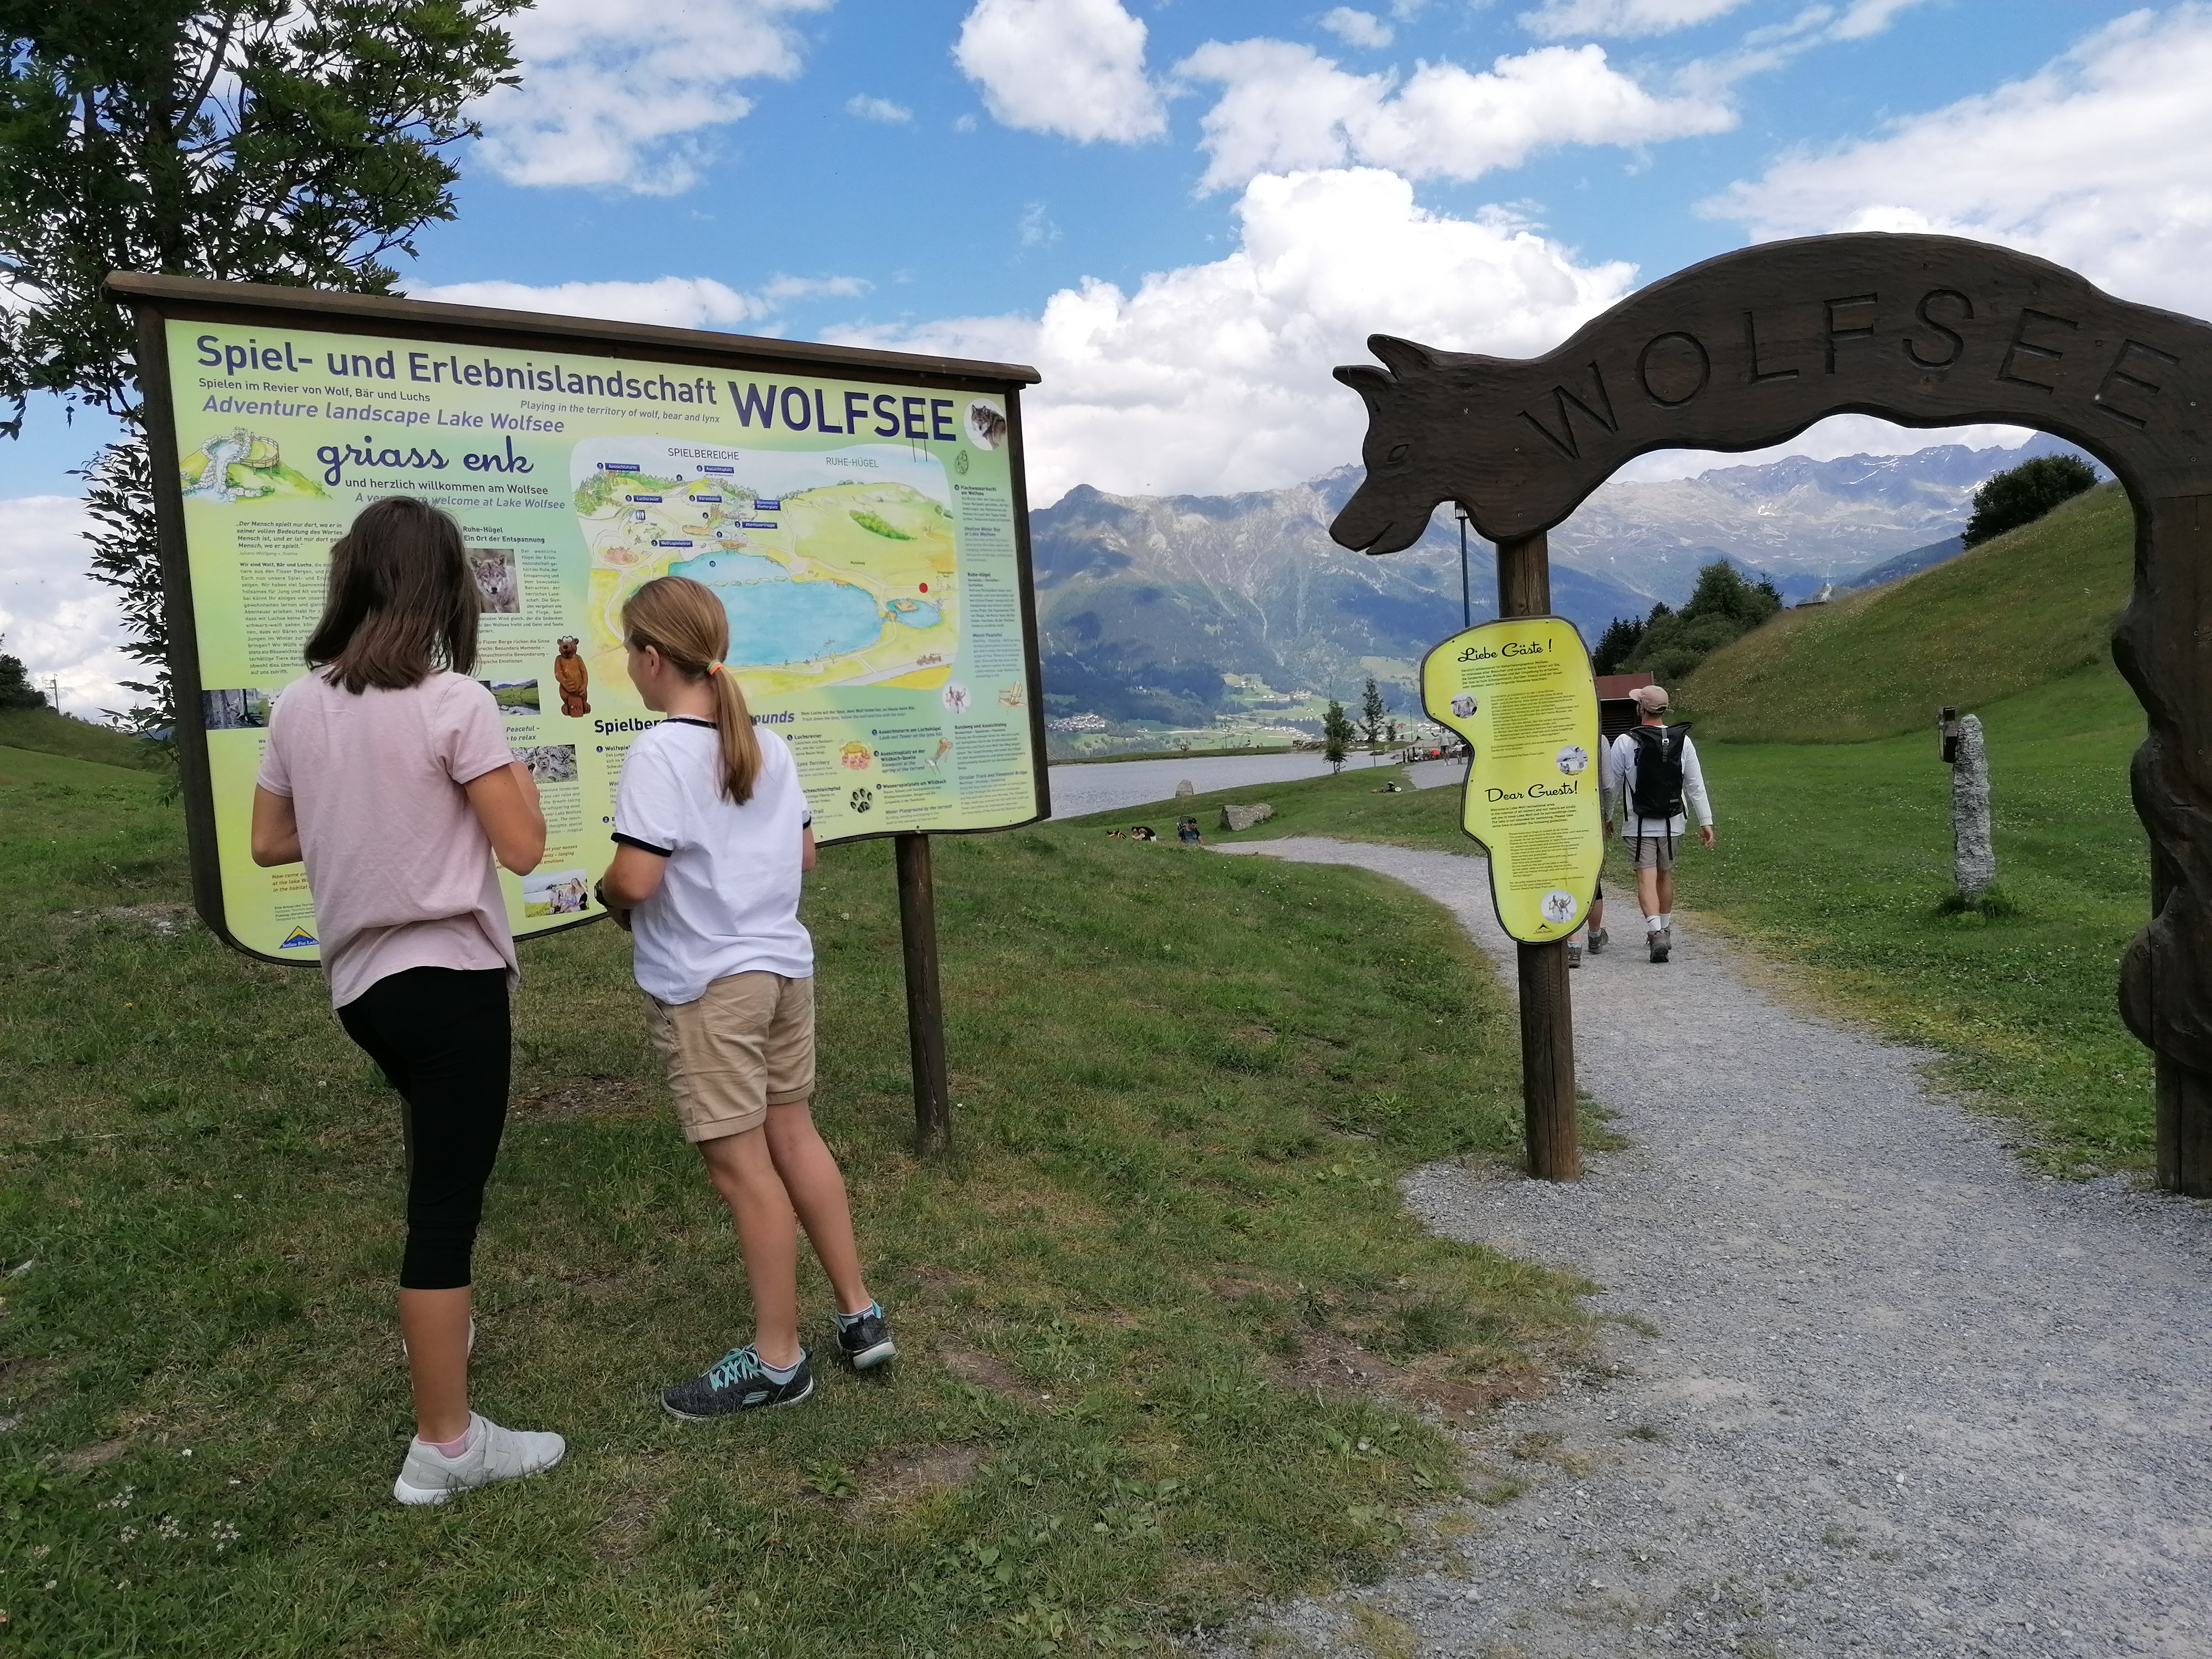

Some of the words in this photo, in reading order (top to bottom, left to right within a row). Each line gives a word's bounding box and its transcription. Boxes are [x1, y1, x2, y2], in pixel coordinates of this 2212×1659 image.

[196, 335, 313, 376] Spiel-
[327, 350, 395, 380] und
[410, 352, 716, 405] Erlebnislandschaft
[1517, 289, 2180, 462] WOLFSEE
[199, 378, 242, 392] Spielen
[246, 380, 259, 389] im
[263, 381, 299, 393] Revier
[302, 384, 321, 394] von
[324, 385, 352, 398] Wolf,
[355, 388, 374, 398] Bär
[378, 389, 397, 399] und
[400, 390, 431, 401] Luchs
[201, 395, 318, 418] Adventure
[326, 401, 431, 427] landscape
[437, 409, 483, 428] Lake
[490, 412, 565, 434] Wolfsee
[520, 400, 555, 413] Playing
[559, 403, 566, 411] in
[570, 405, 584, 413] the
[587, 406, 626, 418] territory
[629, 408, 637, 416] of
[640, 410, 660, 419] wolf,
[663, 411, 682, 420] bear
[685, 413, 700, 421] and
[702, 414, 720, 424] lynx
[727, 380, 957, 442] WOLFSEE
[316, 435, 450, 487] griass
[463, 436, 534, 473] enk
[667, 447, 740, 461] SPIELBEREICHE
[826, 455, 879, 469] RUHE-HÜGEL
[345, 478, 367, 489] und
[370, 478, 415, 491] herzlich
[418, 480, 485, 493] willkommen
[488, 485, 504, 493] am
[507, 484, 549, 495] Wolfsee
[432, 497, 479, 506] welcome
[496, 498, 521, 508] Lake
[525, 499, 565, 509] Wolfsee
[1457, 646, 1498, 662] Liebe
[1501, 641, 1543, 657] Gäste
[1549, 638, 1552, 653] !
[1485, 788, 1524, 802] Dear
[1528, 780, 1578, 798] Guests!
